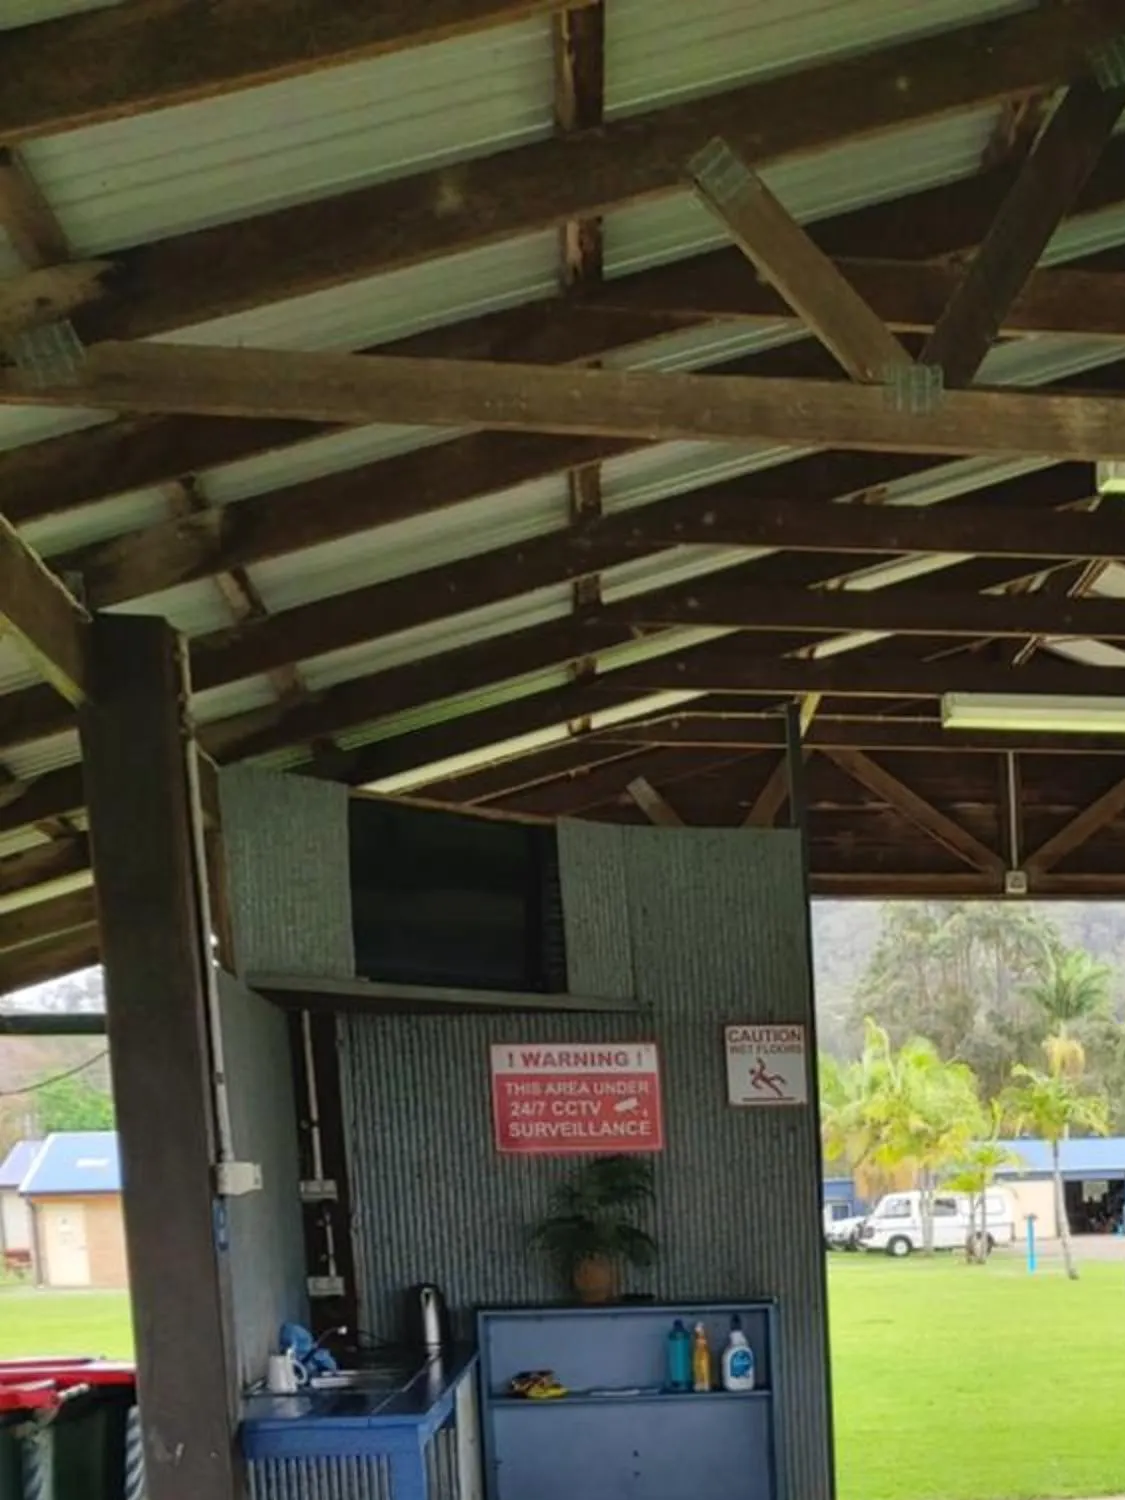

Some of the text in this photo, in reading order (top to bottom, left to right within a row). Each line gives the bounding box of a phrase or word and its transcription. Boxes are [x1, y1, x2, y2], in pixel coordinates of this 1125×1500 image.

[728, 1028, 801, 1043] CAUTION
[520, 1051, 629, 1068] WARNING
[506, 1080, 649, 1096] THIS AREA UNDER
[511, 1100, 602, 1117] 24/7 CCTV
[508, 1120, 653, 1138] SURVEILLANCE
